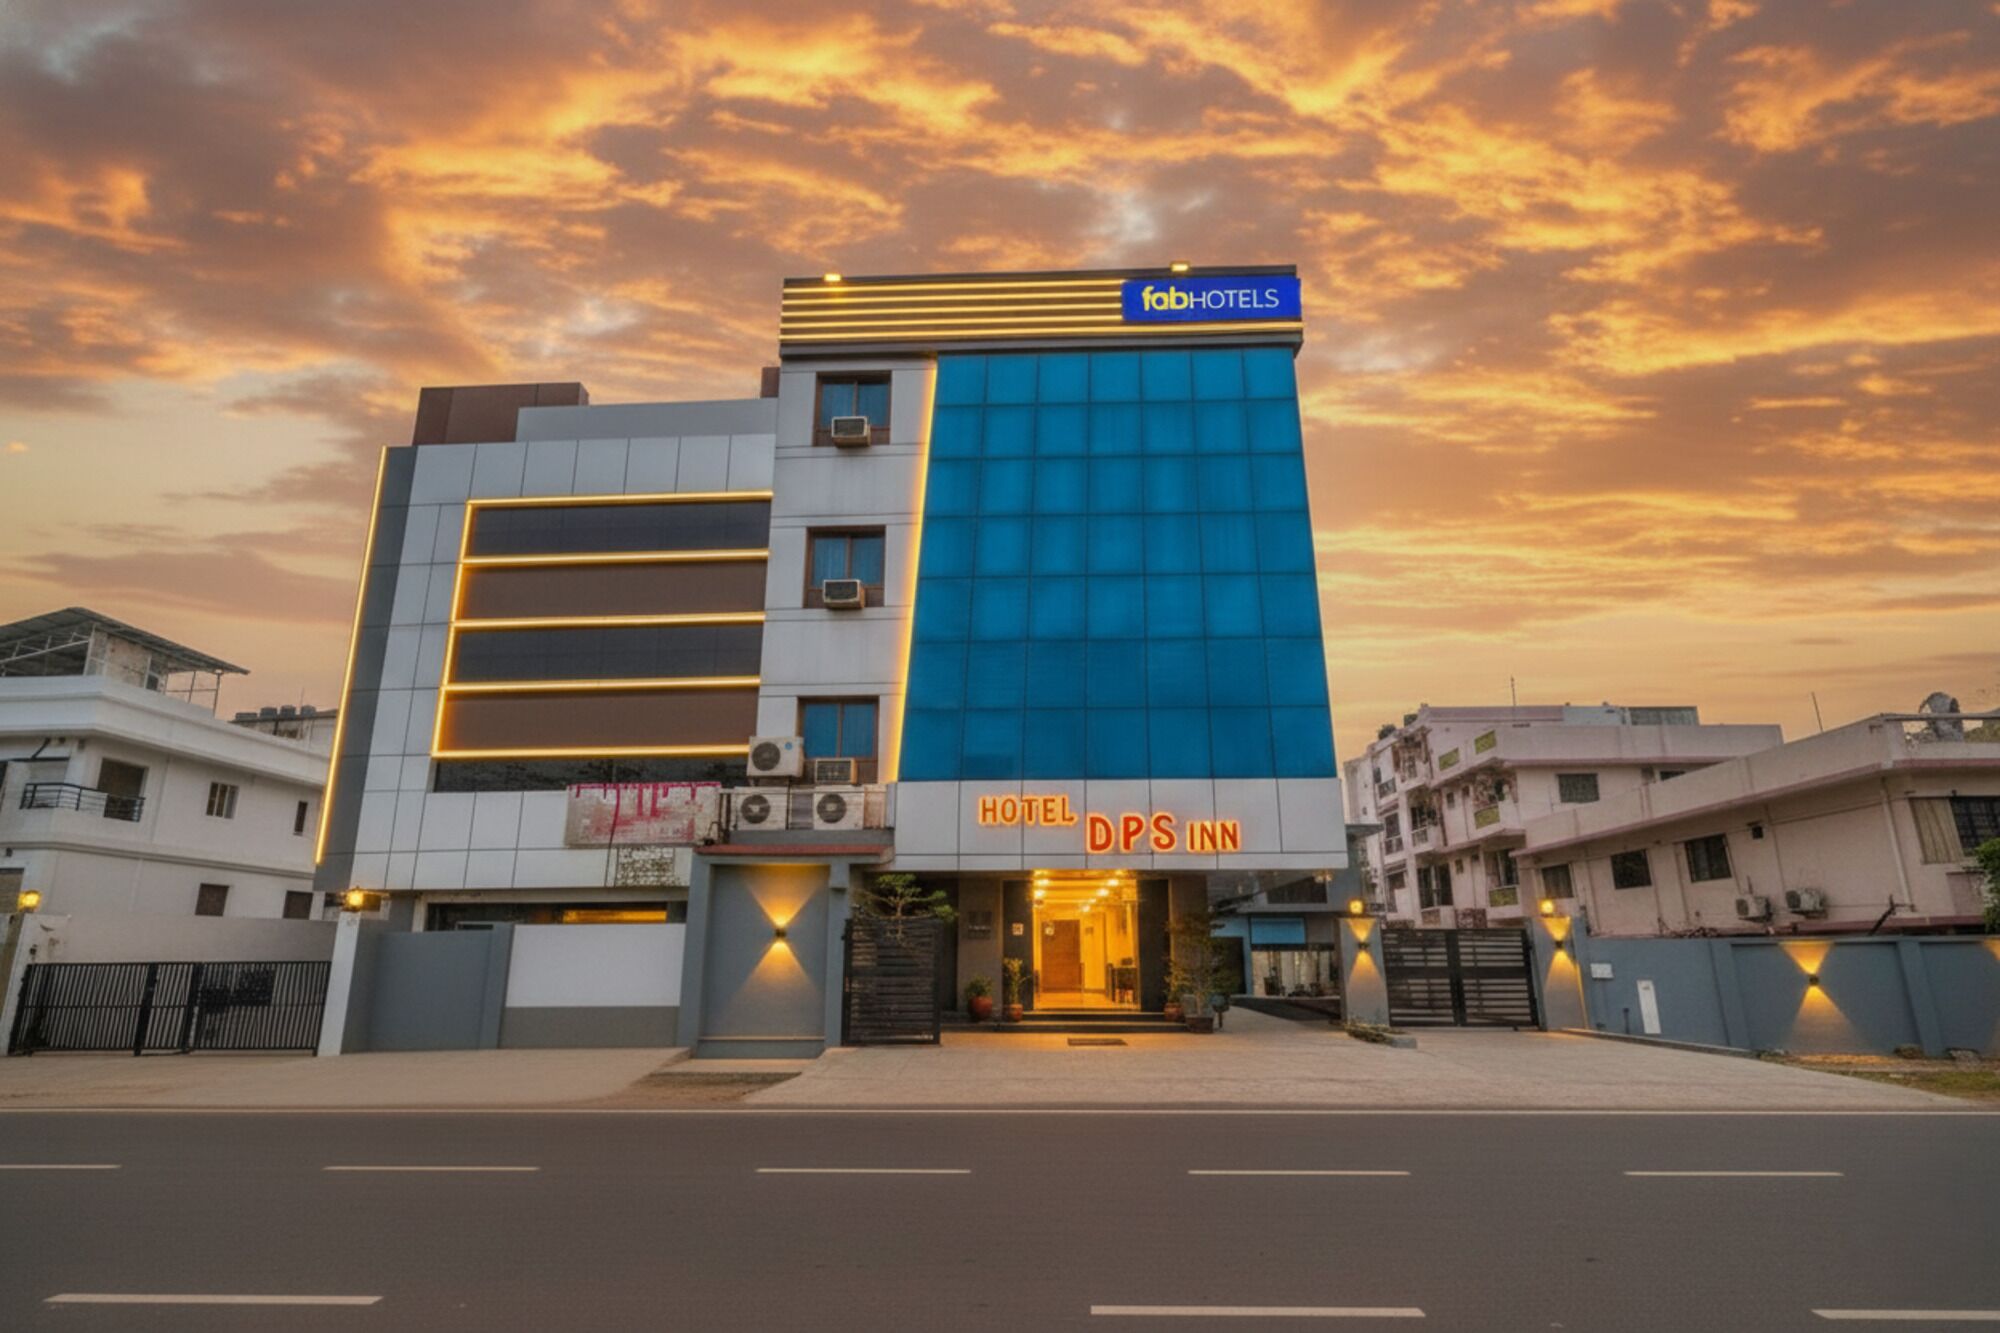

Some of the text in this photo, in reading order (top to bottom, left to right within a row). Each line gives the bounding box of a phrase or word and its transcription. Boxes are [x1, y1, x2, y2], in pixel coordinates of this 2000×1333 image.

[1141, 285, 1280, 312] fabHOTELS
[980, 796, 1239, 852] HOTEL DPS INN
